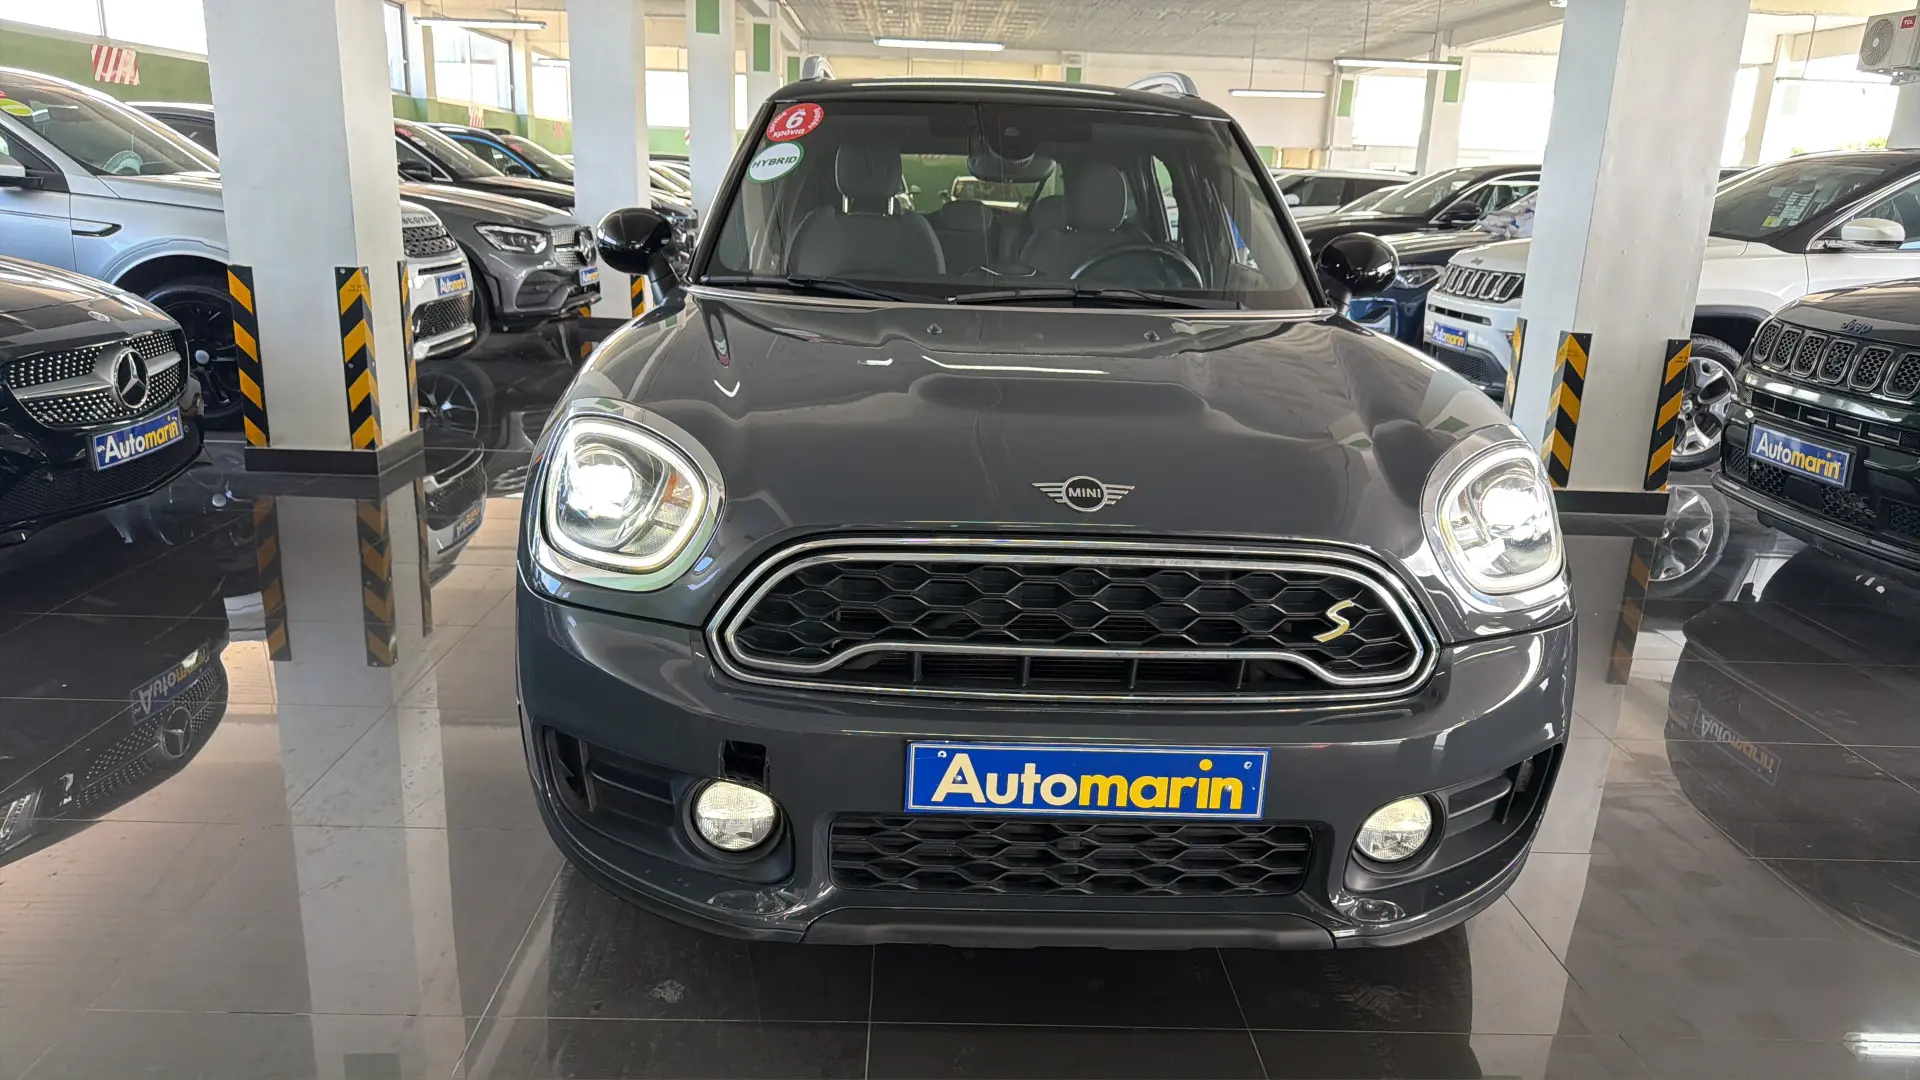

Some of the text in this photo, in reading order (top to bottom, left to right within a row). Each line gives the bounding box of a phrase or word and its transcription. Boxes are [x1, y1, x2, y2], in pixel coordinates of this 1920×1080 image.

[786, 110, 807, 129] 6
[751, 156, 798, 169] HYBRID
[1841, 319, 1873, 334] Jeep
[105, 415, 179, 464] Automarin
[1755, 431, 1840, 480] Automarin
[1068, 487, 1102, 498] MINI
[1312, 600, 1355, 643] S
[930, 753, 1243, 810] Automarin
